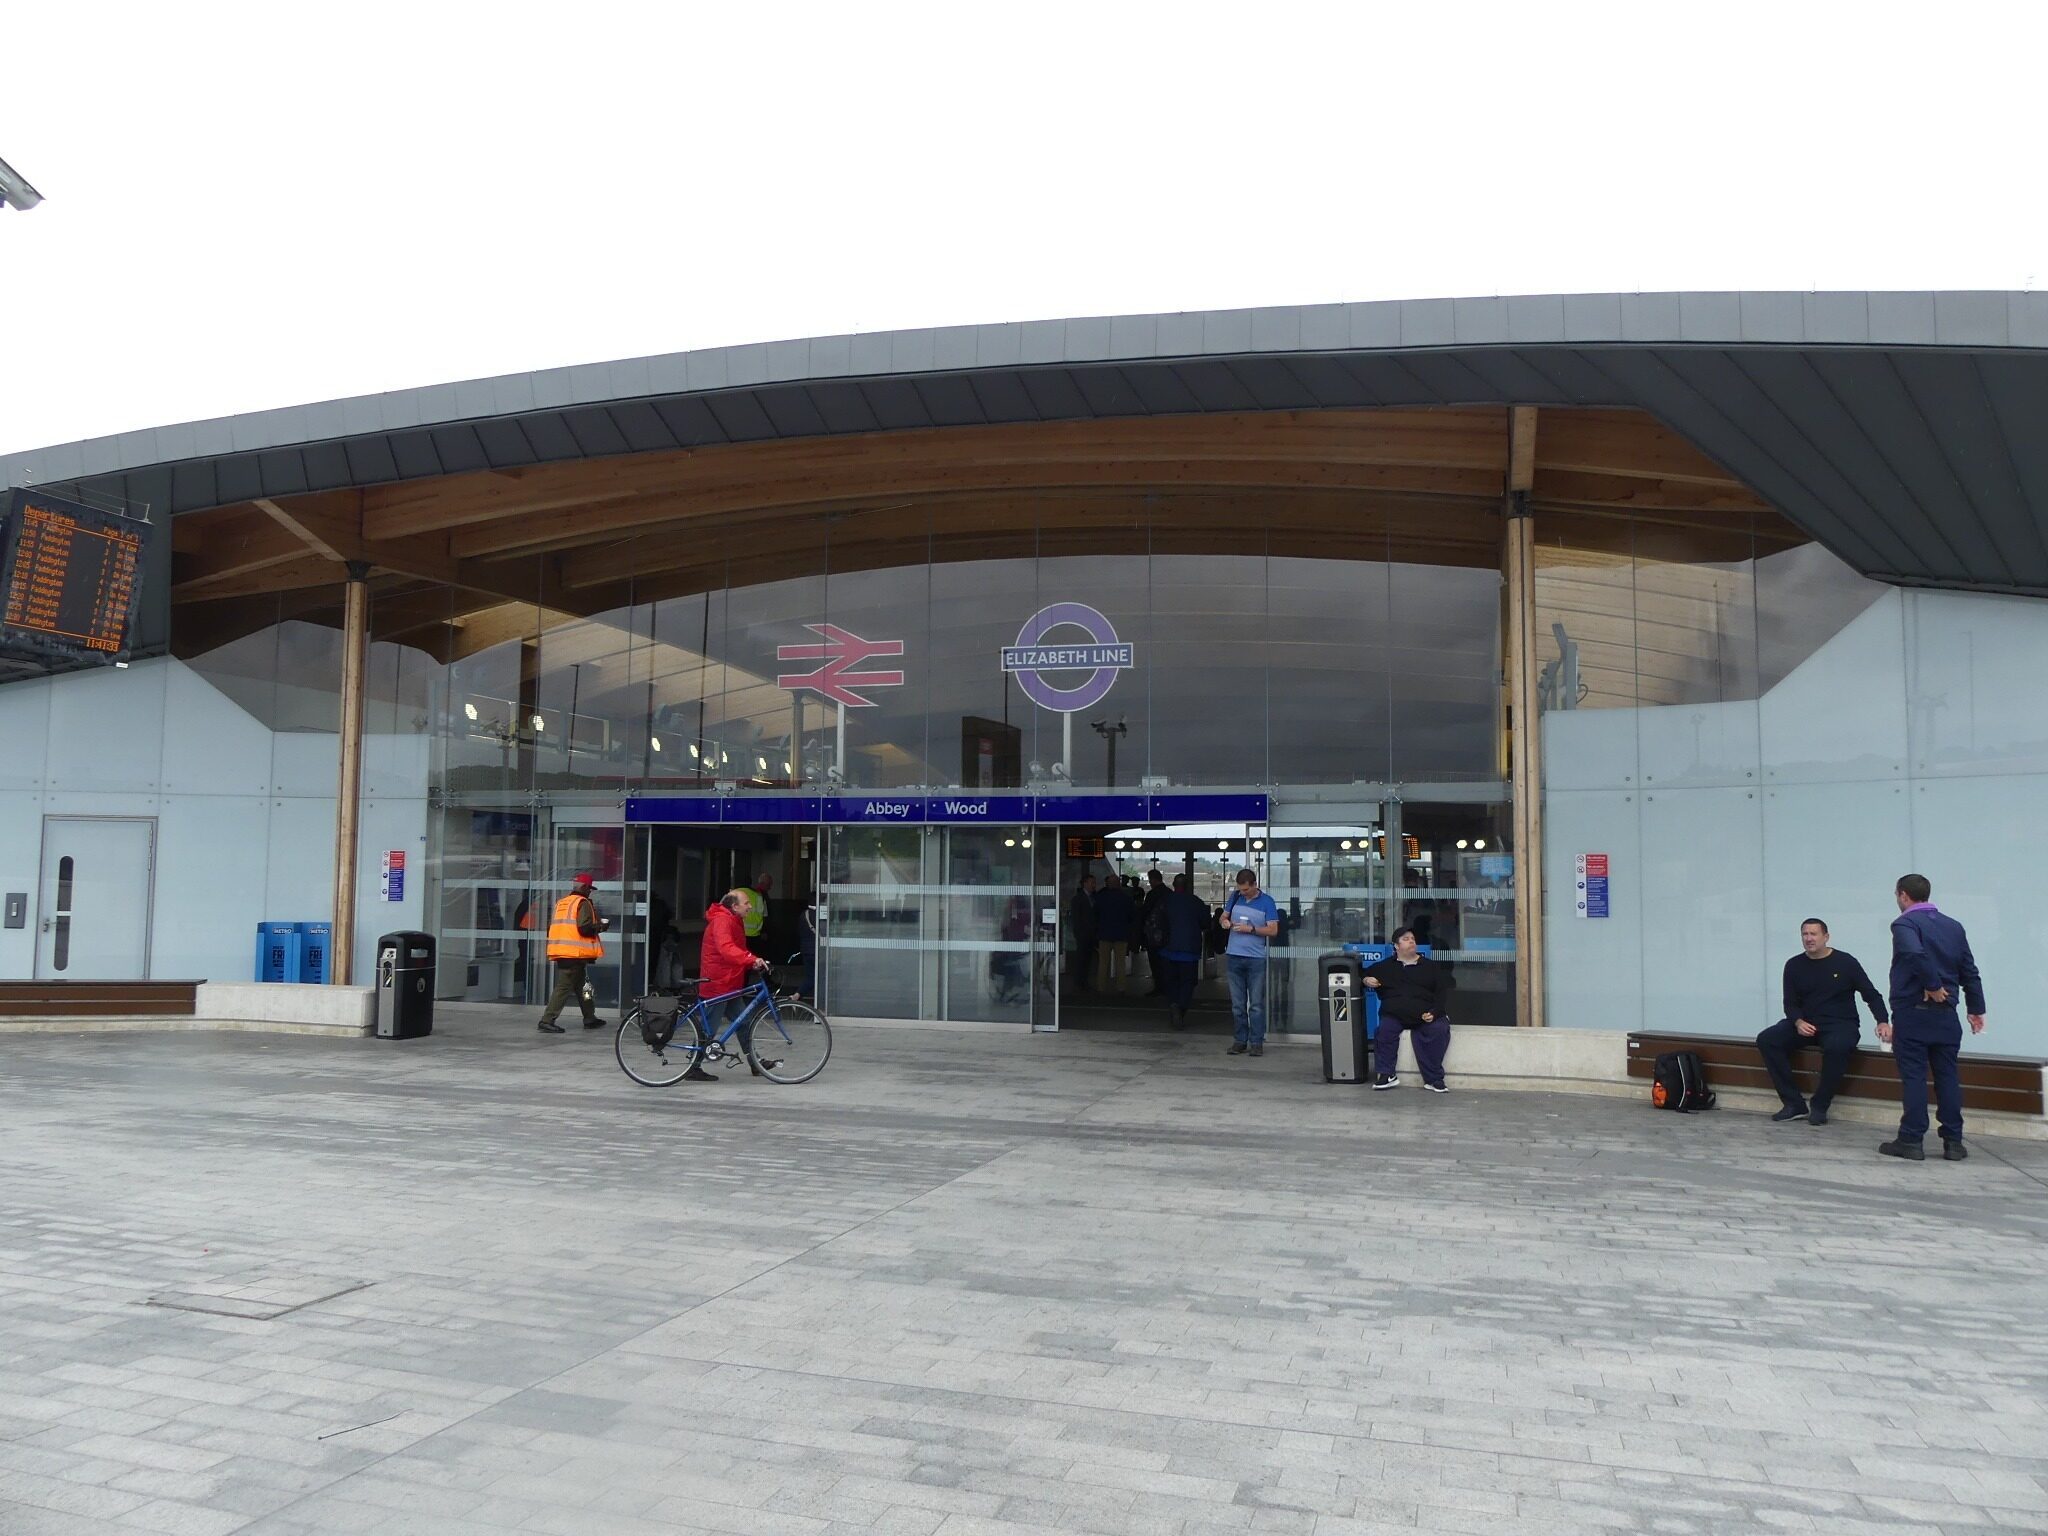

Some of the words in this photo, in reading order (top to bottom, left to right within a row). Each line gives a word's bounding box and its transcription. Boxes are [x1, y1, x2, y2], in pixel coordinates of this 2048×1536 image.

[24, 505, 75, 525] Departures
[43, 522, 72, 537] Paddington
[41, 532, 70, 546] Paddington
[39, 543, 68, 557] Paddington
[37, 553, 66, 567] Paddington
[35, 563, 64, 577] Paddington
[33, 573, 62, 587] Paddington
[31, 584, 60, 598] Paddington
[29, 594, 58, 608] Paddington
[27, 604, 56, 618] Paddington
[25, 614, 54, 628] Paddington
[1006, 650, 1087, 665] ELIZABETH
[1093, 649, 1129, 663] LINE
[865, 802, 909, 817] Abbey
[945, 802, 987, 814] Wood
[1360, 952, 1381, 961] TRO
